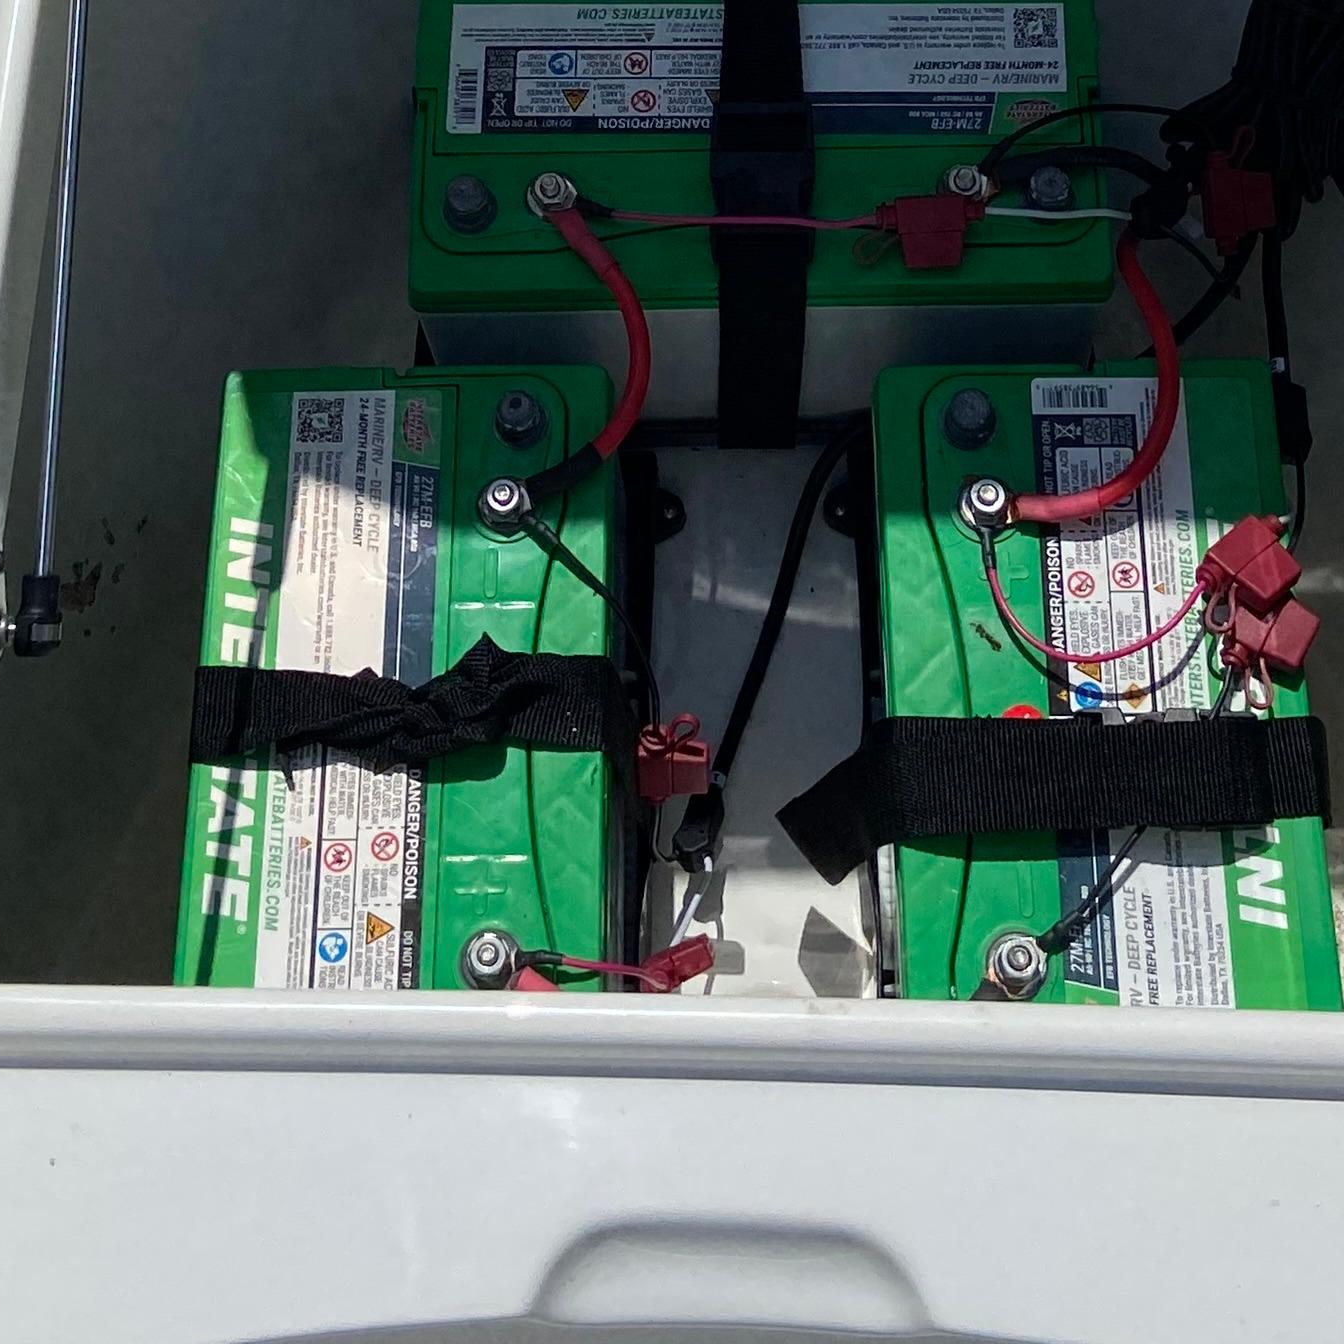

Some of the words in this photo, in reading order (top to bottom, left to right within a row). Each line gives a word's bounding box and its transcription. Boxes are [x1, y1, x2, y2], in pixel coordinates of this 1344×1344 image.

[576, 8, 723, 19] STATEBATTERIES.COM
[913, 60, 980, 70] REPLACEMENT
[981, 60, 1006, 69] FREE
[1008, 60, 1059, 69] 24-MONTH
[907, 73, 945, 84] CYCLE
[948, 73, 977, 84] DEEP
[992, 73, 1059, 84] MARINE/RV
[525, 119, 537, 127] TIP
[597, 118, 709, 129] DANGER/POISON
[357, 397, 369, 448] 24-MONTH
[371, 397, 386, 465] MARINE/RV
[356, 450, 367, 473] FREE
[1044, 458, 1053, 472] TIP
[369, 479, 382, 510] DEEP
[420, 476, 434, 528] 27M-EFB
[353, 475, 366, 547] REPLACEMENT
[367, 513, 380, 553] CYCLE
[1065, 557, 1074, 569] NO
[1046, 536, 1065, 653] ANGER/POISON
[1133, 614, 1143, 633] HELP
[200, 517, 275, 922] INTETATE
[404, 769, 422, 900] DANGER/POISON
[264, 774, 287, 932] ATEBATTERIES.COM
[390, 863, 399, 876] NO
[1123, 885, 1139, 931] CYCLE
[403, 930, 413, 945] DO
[1102, 913, 1114, 964] TECHNOLOGY
[1141, 892, 1158, 976] REPLACEMENT
[402, 947, 412, 968] NOT
[1126, 934, 1141, 970] DEEP
[384, 977, 394, 991] AC
[401, 971, 412, 988] TIP
[1147, 978, 1160, 1006] FREE
